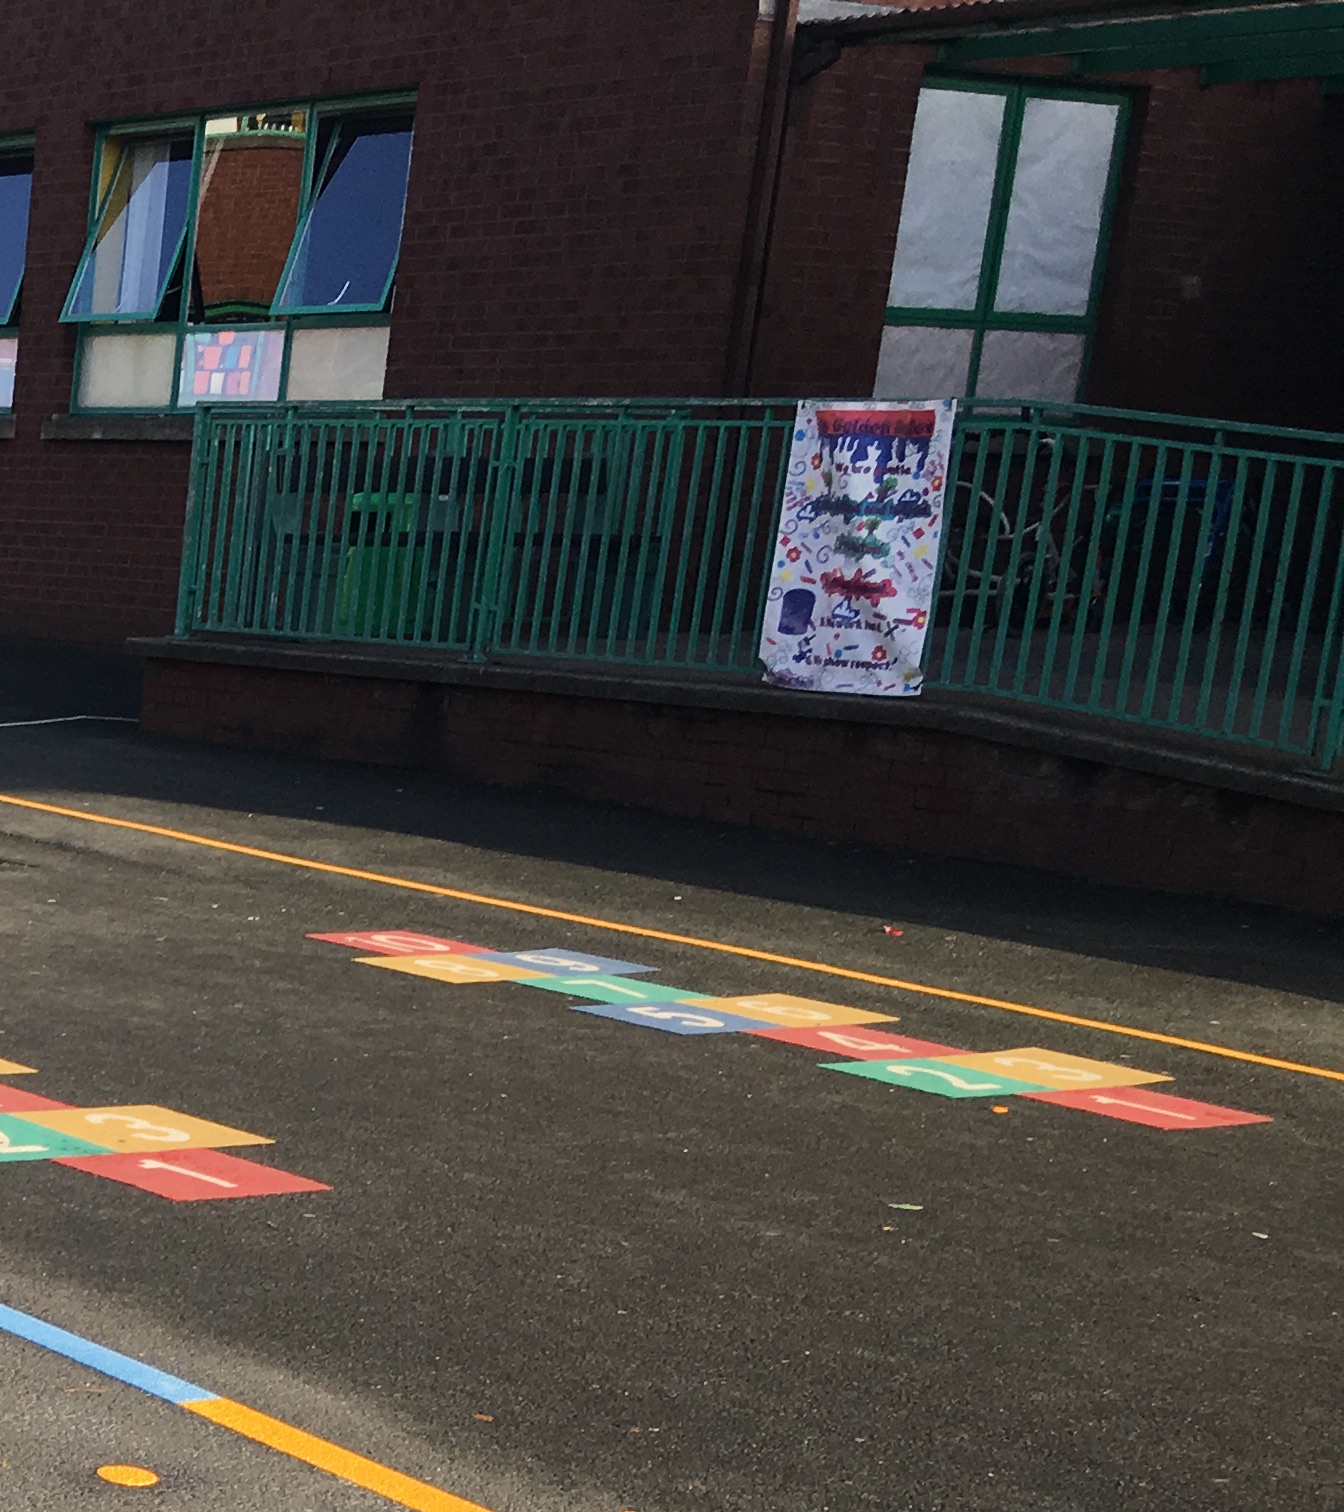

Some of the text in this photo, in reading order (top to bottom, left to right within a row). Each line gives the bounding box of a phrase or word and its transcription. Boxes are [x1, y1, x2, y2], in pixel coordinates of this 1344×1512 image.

[345, 934, 450, 952] 10
[413, 959, 499, 977] 8
[515, 953, 601, 972] 9
[561, 979, 646, 998] 7
[625, 1006, 725, 1028] 5
[736, 1000, 832, 1020] 6
[816, 1031, 912, 1053] 4
[887, 1065, 1002, 1090] 2
[993, 1056, 1104, 1081] 3
[1091, 1095, 1196, 1120] 1
[84, 1113, 190, 1142] 3
[138, 1159, 239, 1188] 1
